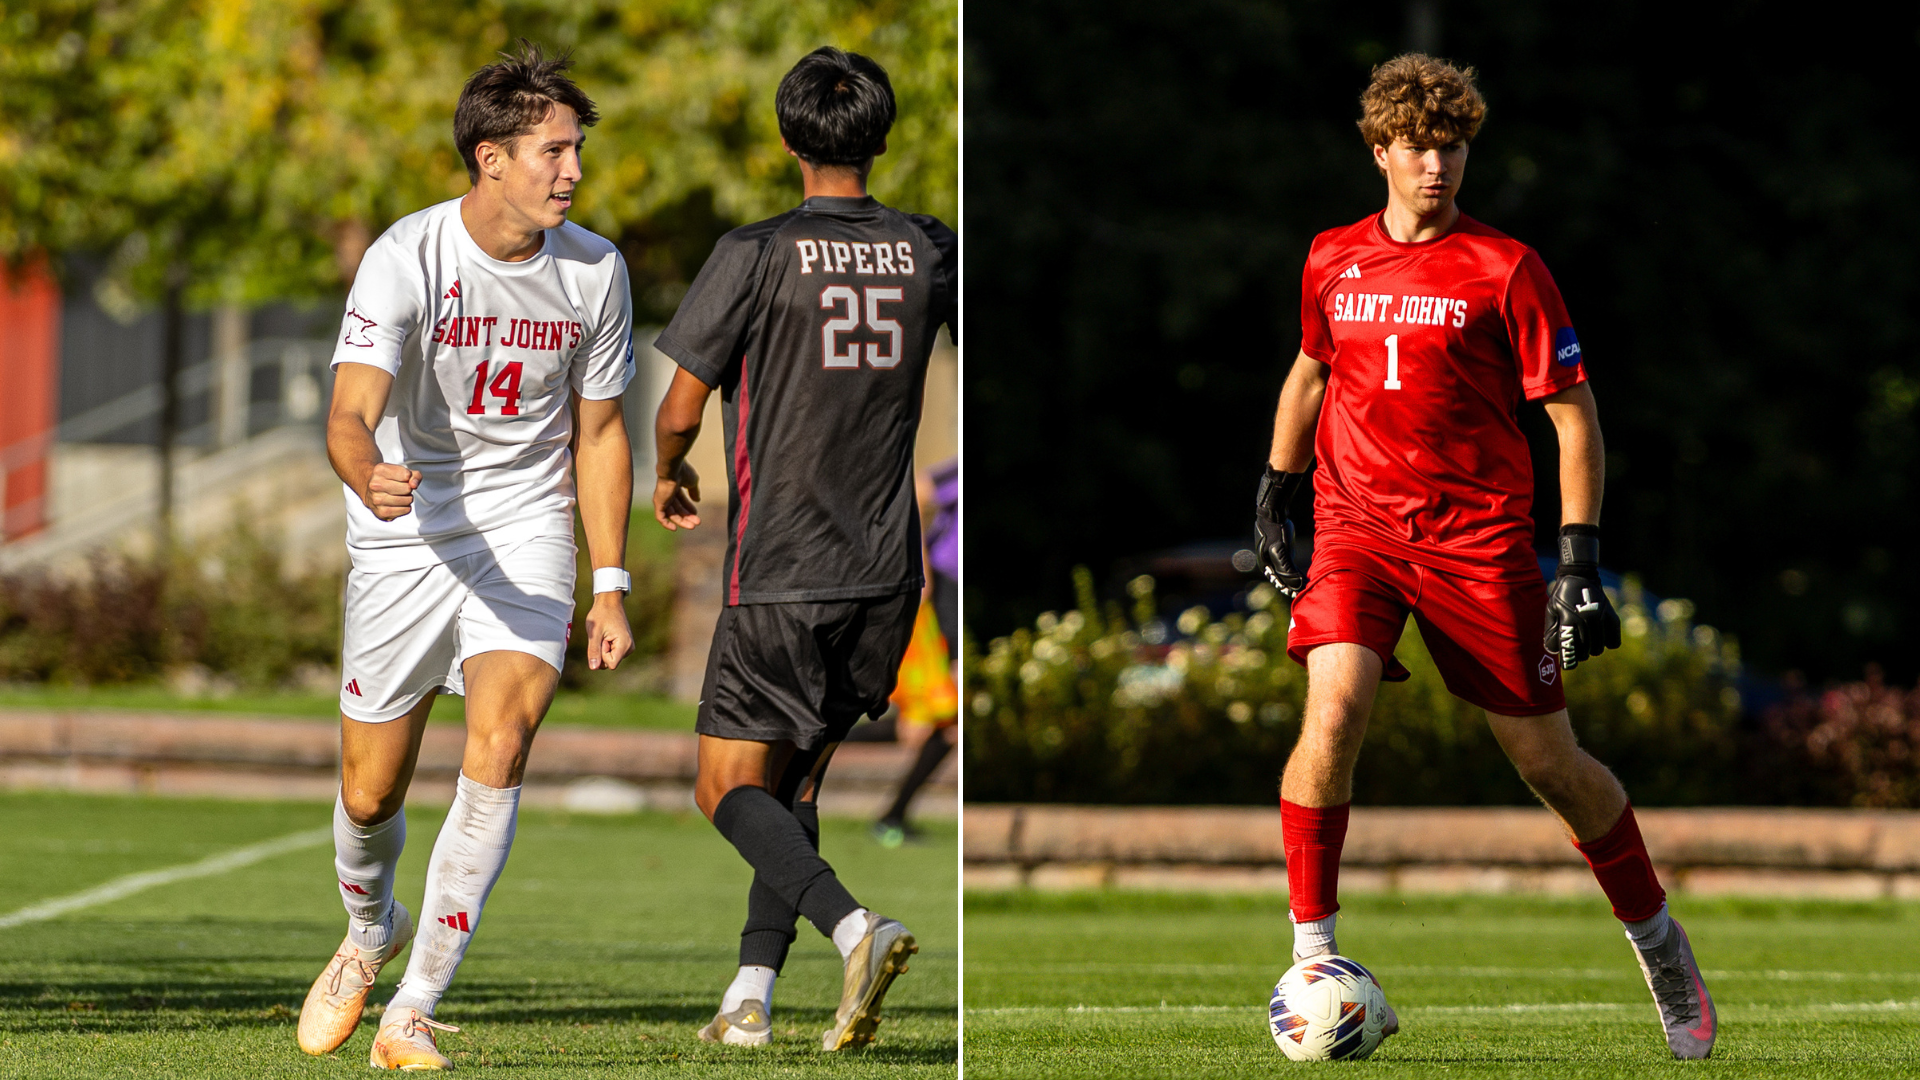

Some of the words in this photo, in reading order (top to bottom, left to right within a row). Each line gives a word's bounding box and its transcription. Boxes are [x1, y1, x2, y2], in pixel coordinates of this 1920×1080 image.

[795, 238, 916, 275] PIPERS
[432, 316, 498, 348] SAINT
[500, 318, 582, 351] JOHN'S
[819, 283, 905, 370] 25
[1334, 293, 1394, 323] SAINT
[1394, 295, 1468, 329] JOHN'S
[1384, 334, 1402, 390] 1
[466, 359, 524, 416] 14
[1560, 625, 1577, 670] TITAN
